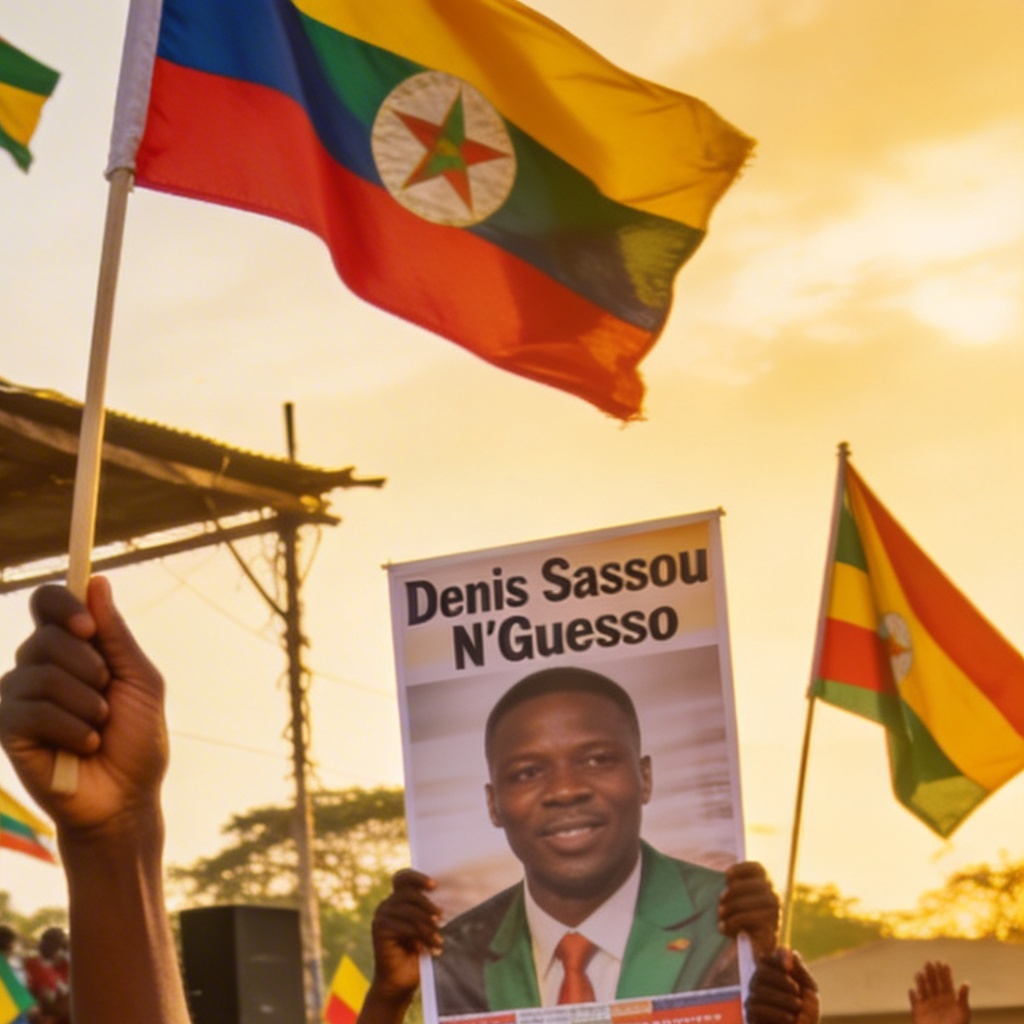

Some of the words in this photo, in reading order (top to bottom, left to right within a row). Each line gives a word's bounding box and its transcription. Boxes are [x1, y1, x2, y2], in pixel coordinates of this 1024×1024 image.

[405, 567, 529, 627] Denis
[541, 548, 708, 603] Sassou
[452, 605, 679, 670] N'Guesso
